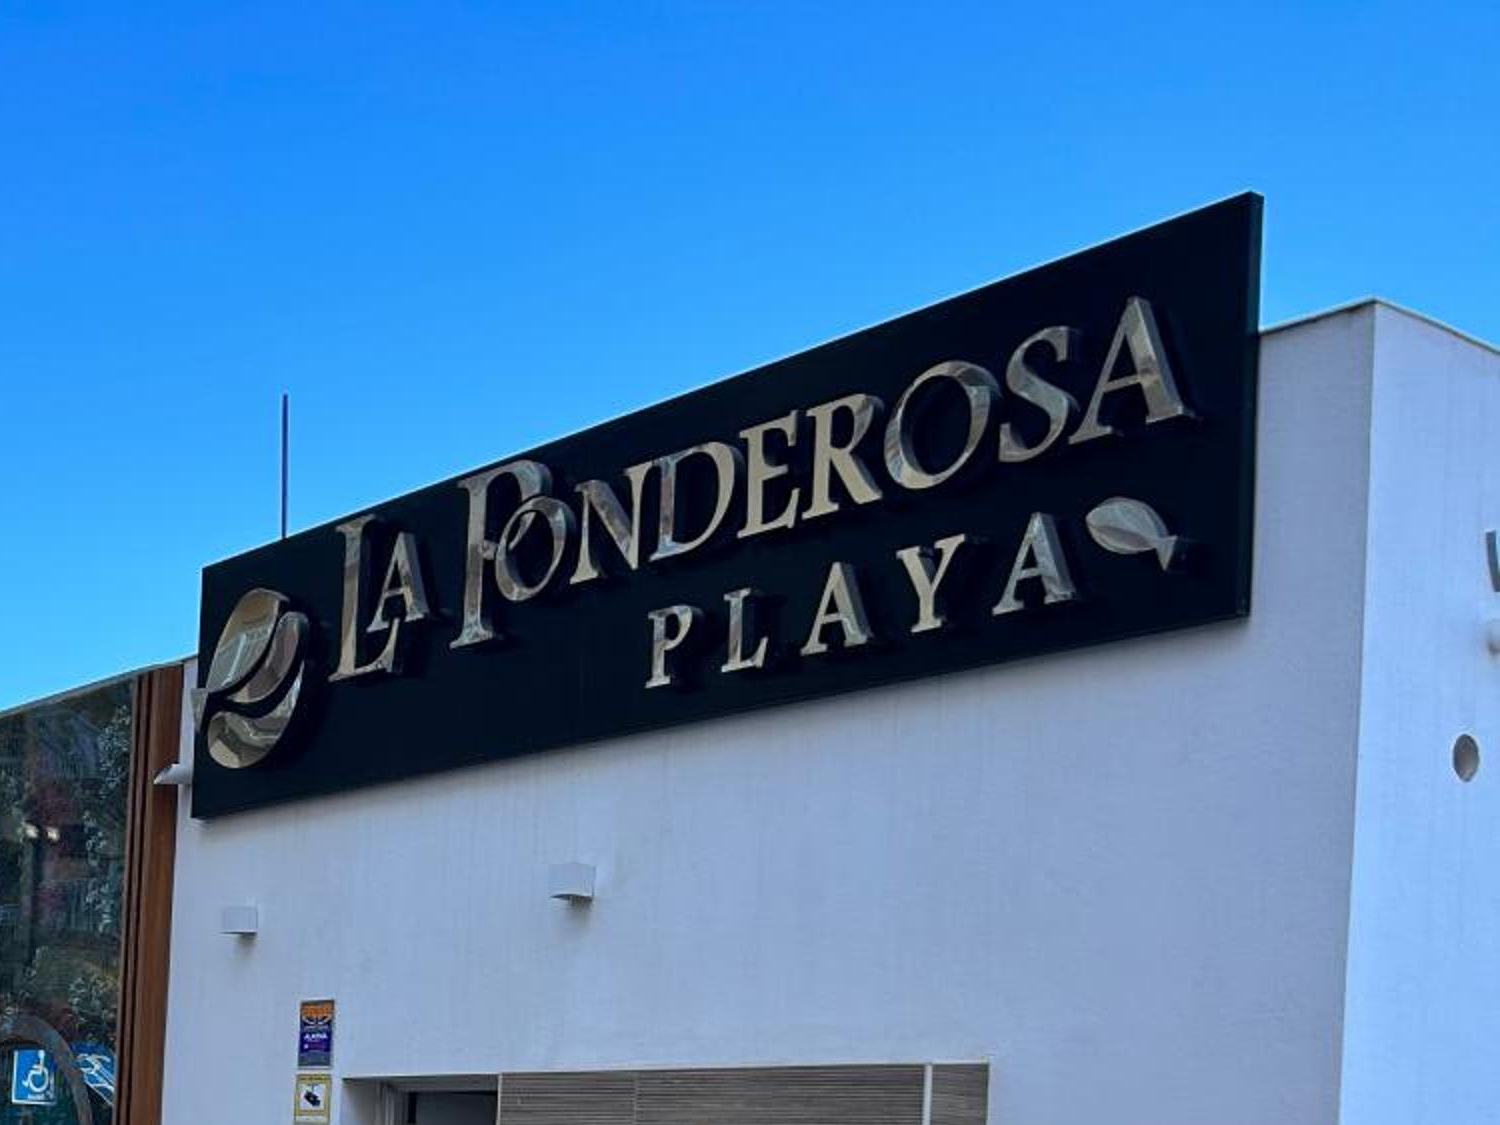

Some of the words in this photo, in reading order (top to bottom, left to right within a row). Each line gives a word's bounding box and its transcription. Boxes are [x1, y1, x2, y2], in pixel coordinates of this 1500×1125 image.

[328, 513, 431, 683] LA
[450, 296, 1194, 650] PONDEROSA
[644, 511, 1078, 689] PLAYA
